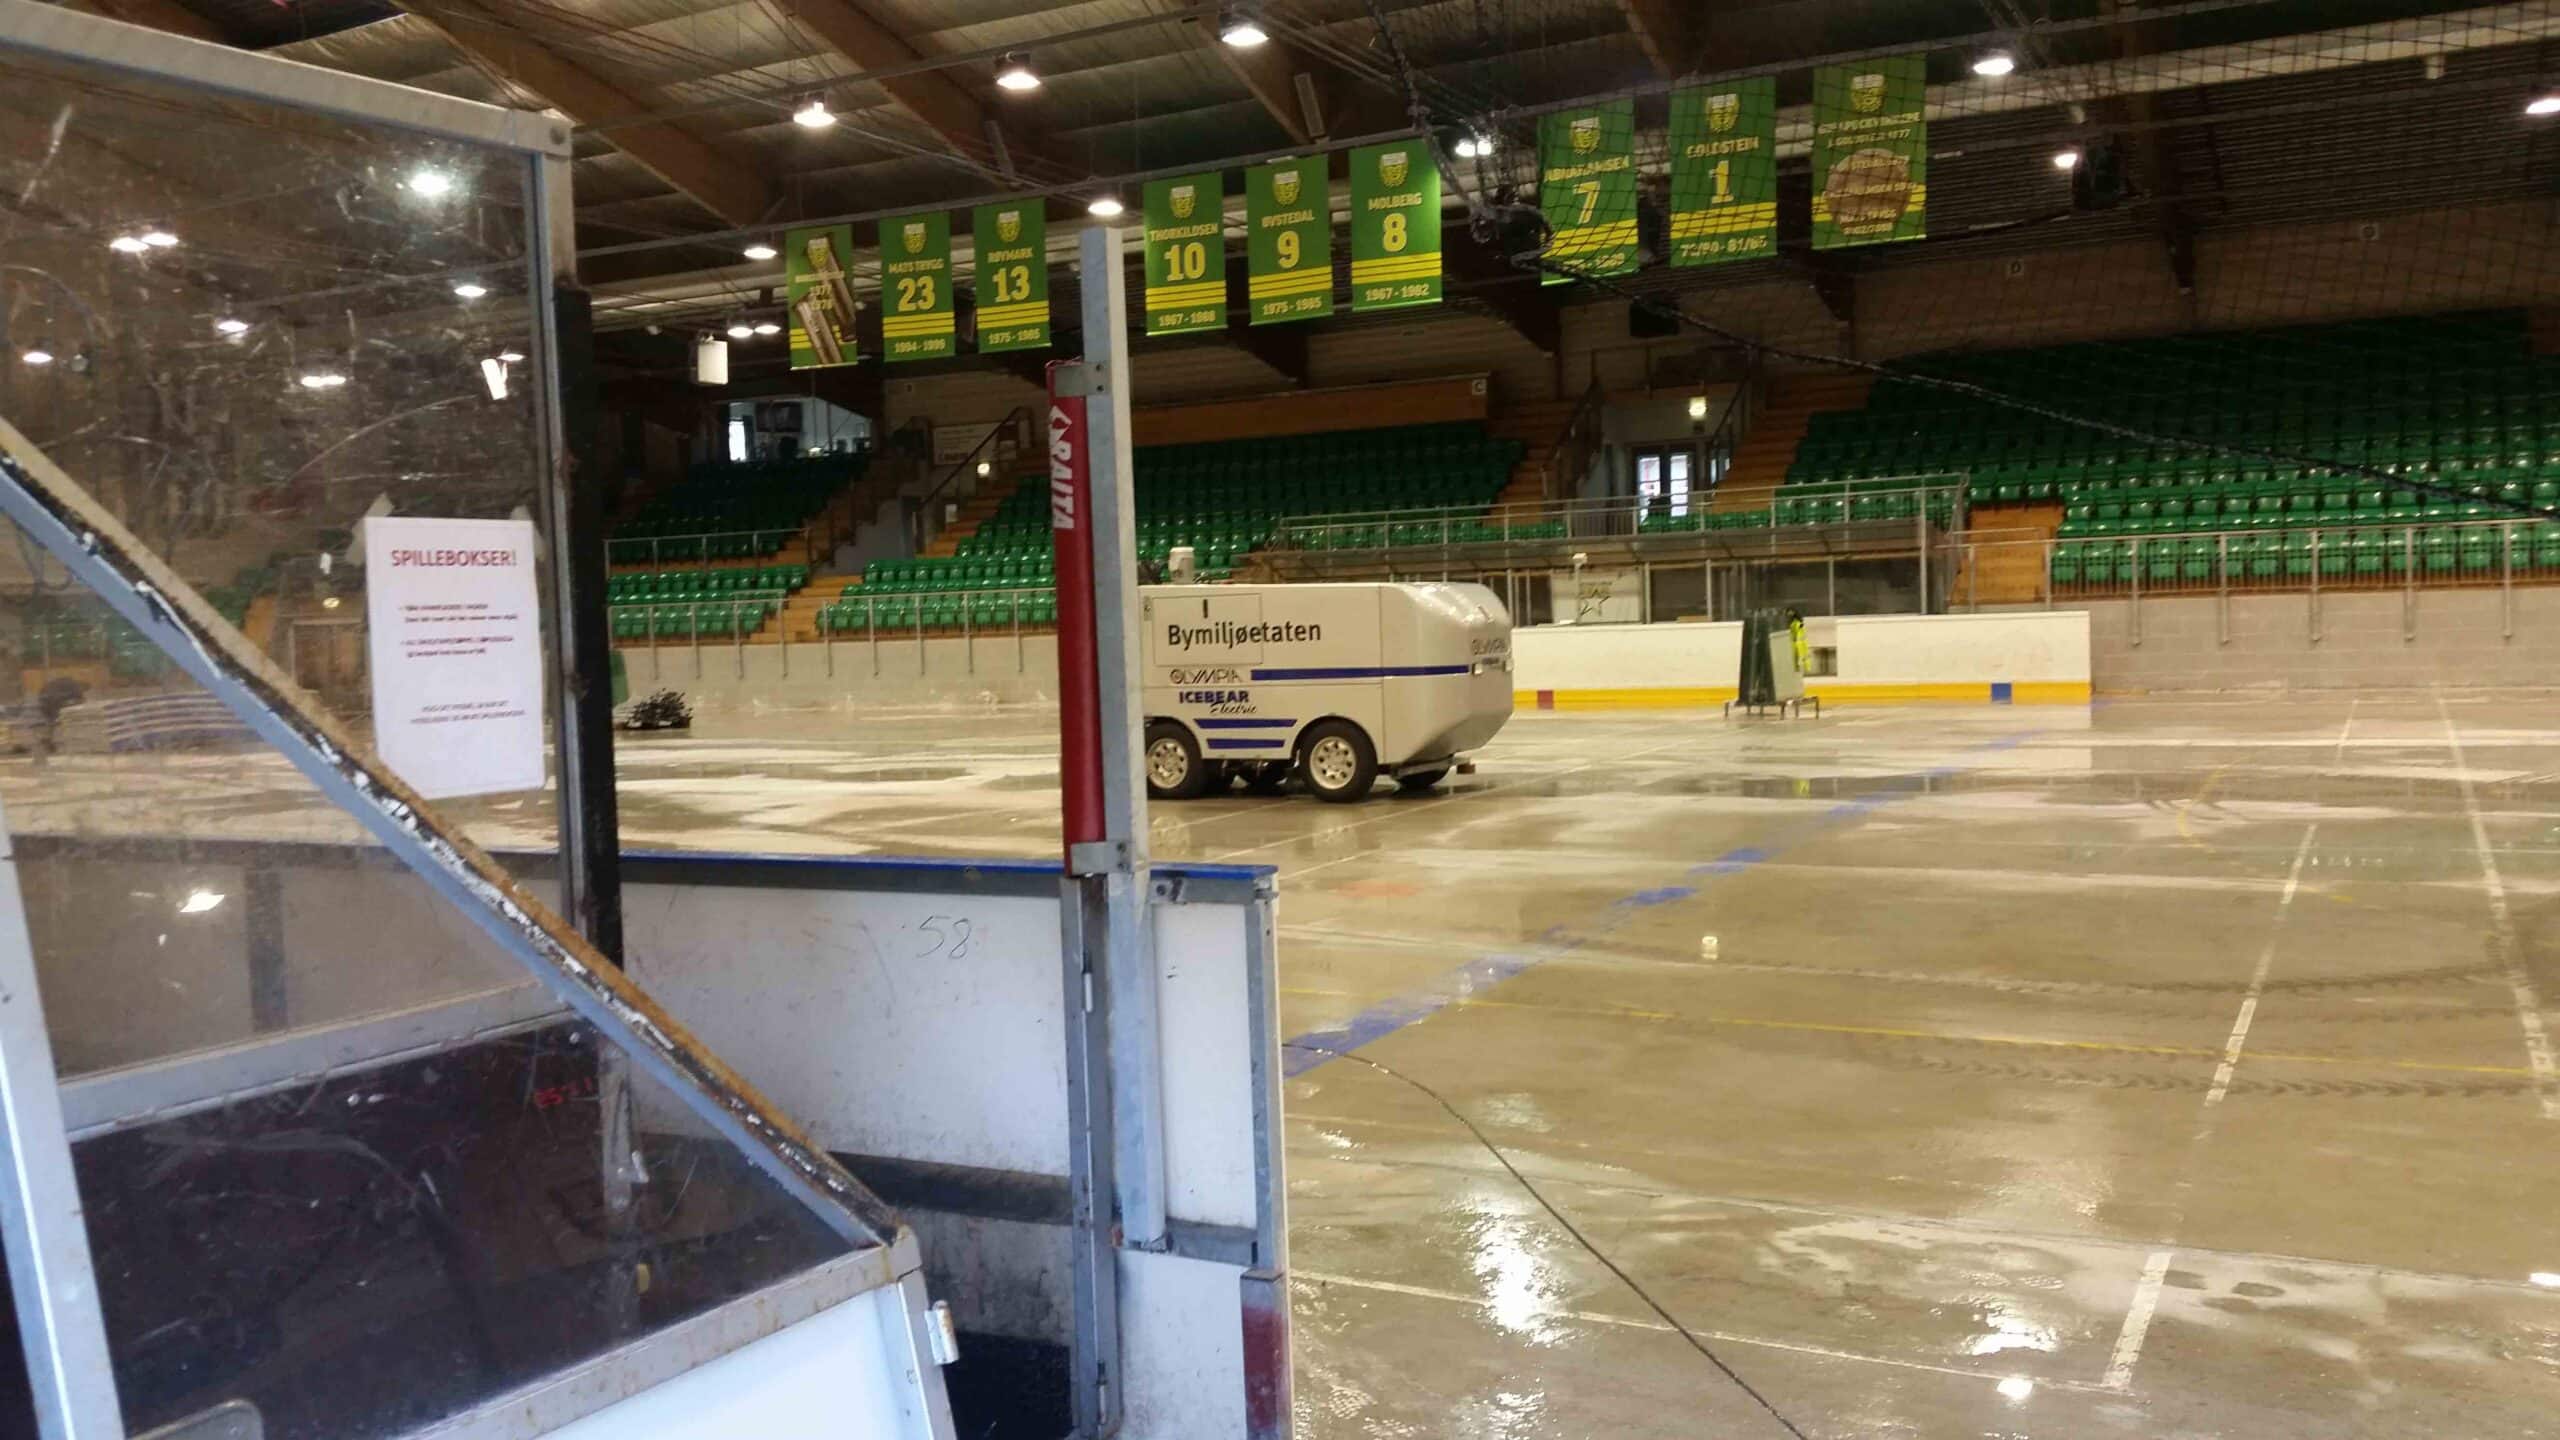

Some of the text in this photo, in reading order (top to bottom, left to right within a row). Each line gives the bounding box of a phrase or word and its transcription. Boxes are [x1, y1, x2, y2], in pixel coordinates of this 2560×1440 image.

[1708, 160, 1734, 204] 1
[1572, 181, 1601, 225] 7
[1277, 230, 1301, 269] 9
[1383, 212, 1408, 252] 8
[1164, 242, 1206, 282] 10
[897, 275, 936, 312] 23
[992, 265, 1031, 303] 13
[391, 549, 518, 568] SPILLEBOKSER!
[1168, 622, 1321, 651] Bymiljøetaten
[1169, 668, 1243, 685] OLYMPIA
[1179, 691, 1249, 704] ICEBEAR
[915, 914, 973, 959] 58
